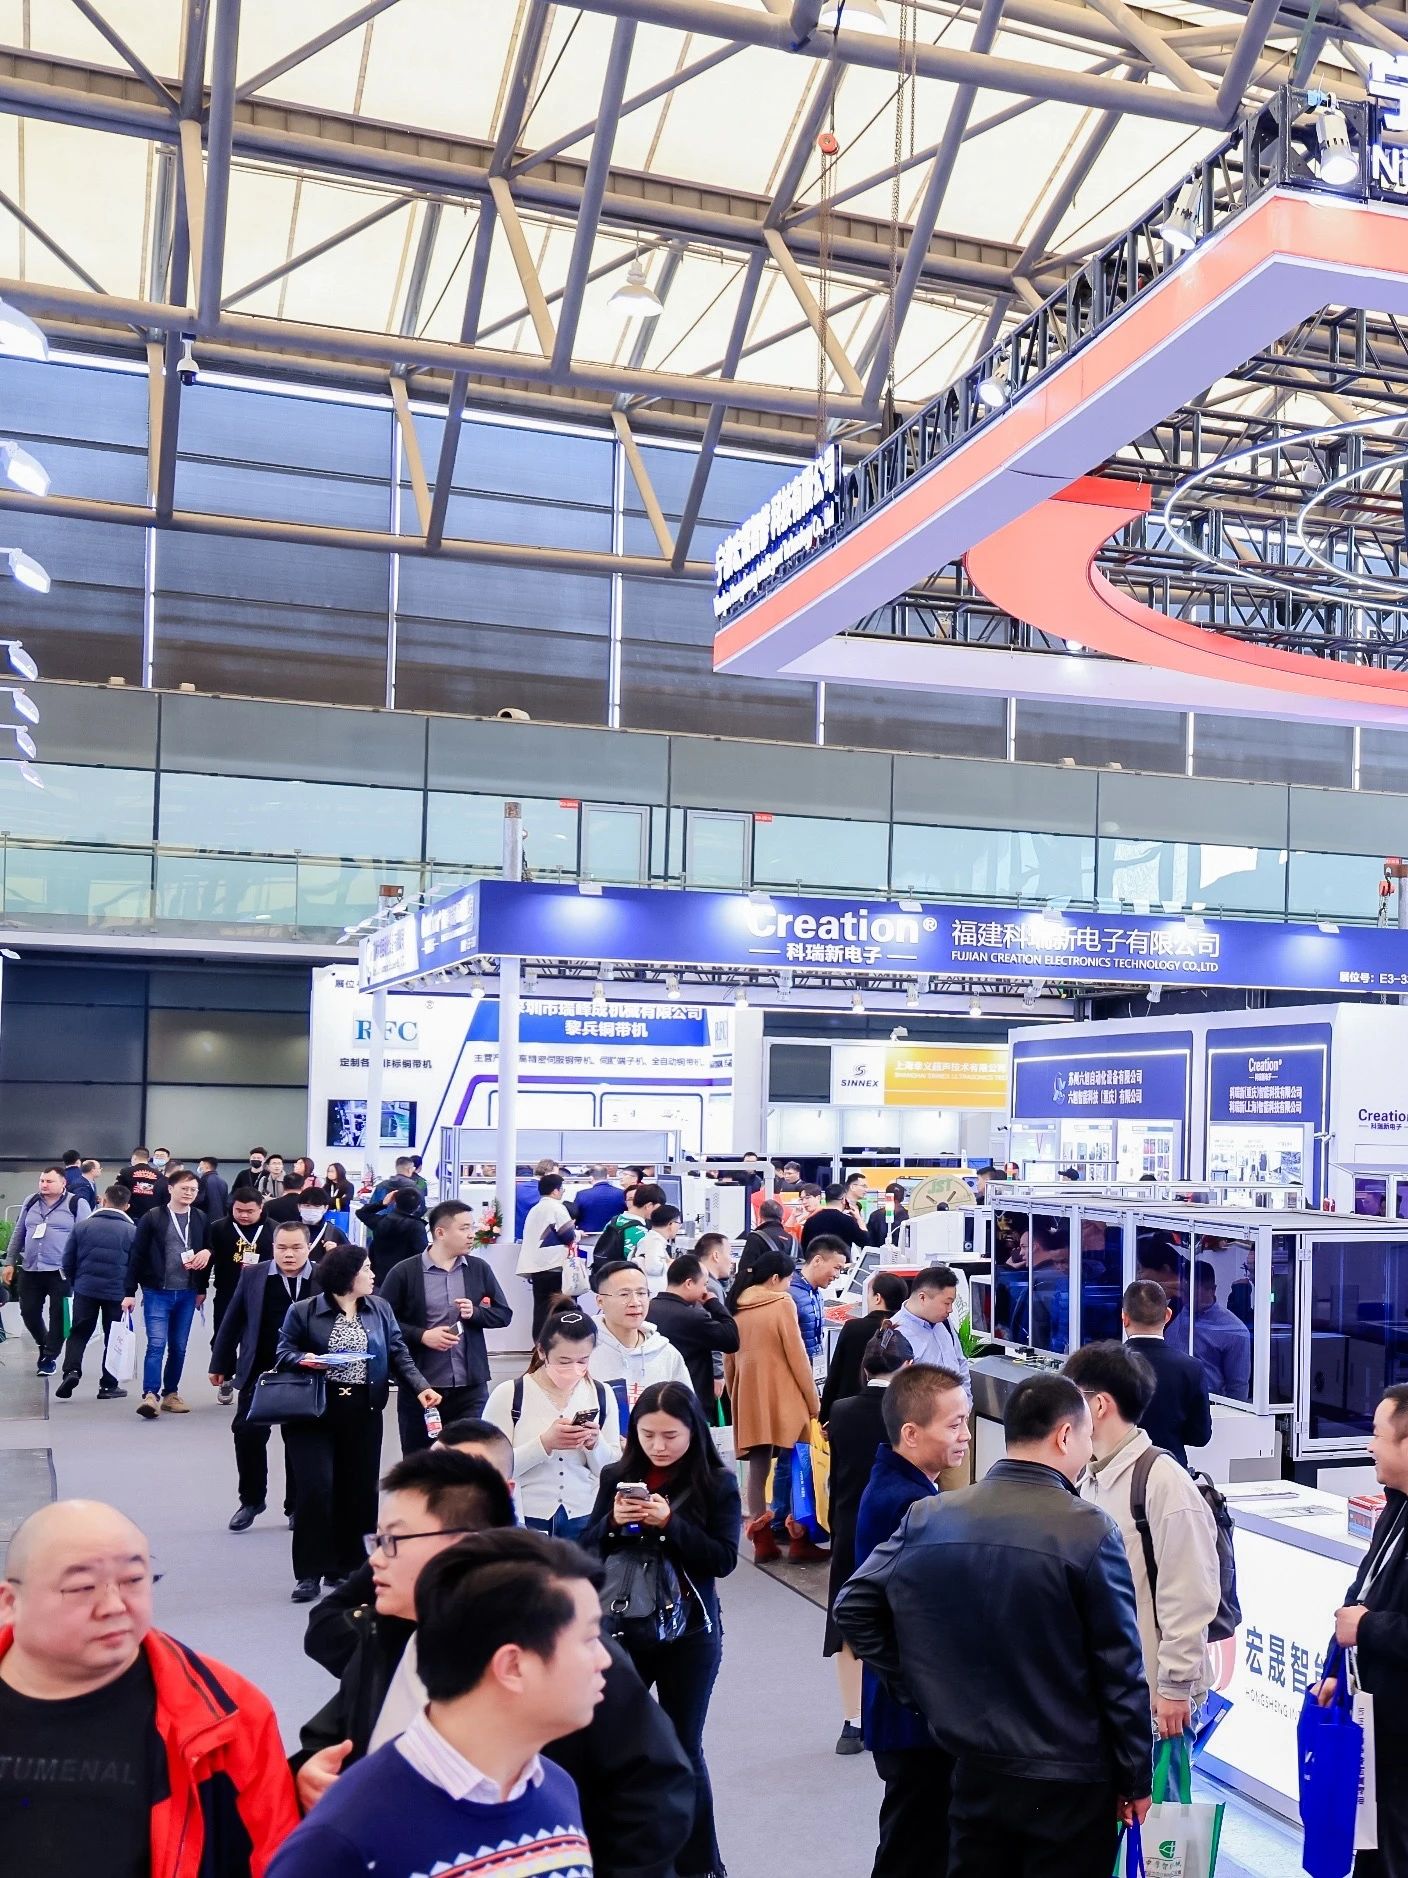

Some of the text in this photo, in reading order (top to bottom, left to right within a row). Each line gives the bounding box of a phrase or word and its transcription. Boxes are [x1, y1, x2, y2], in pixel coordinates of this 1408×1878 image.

[786, 942, 882, 965] 科瑞新电子
[951, 950, 988, 963] FUJIAN
[990, 952, 1042, 965] CREATION
[1044, 955, 1111, 968] ELECTRONICS
[1113, 958, 1179, 971] TECHNOLOGY
[840, 1079, 880, 1088] SINNEX
